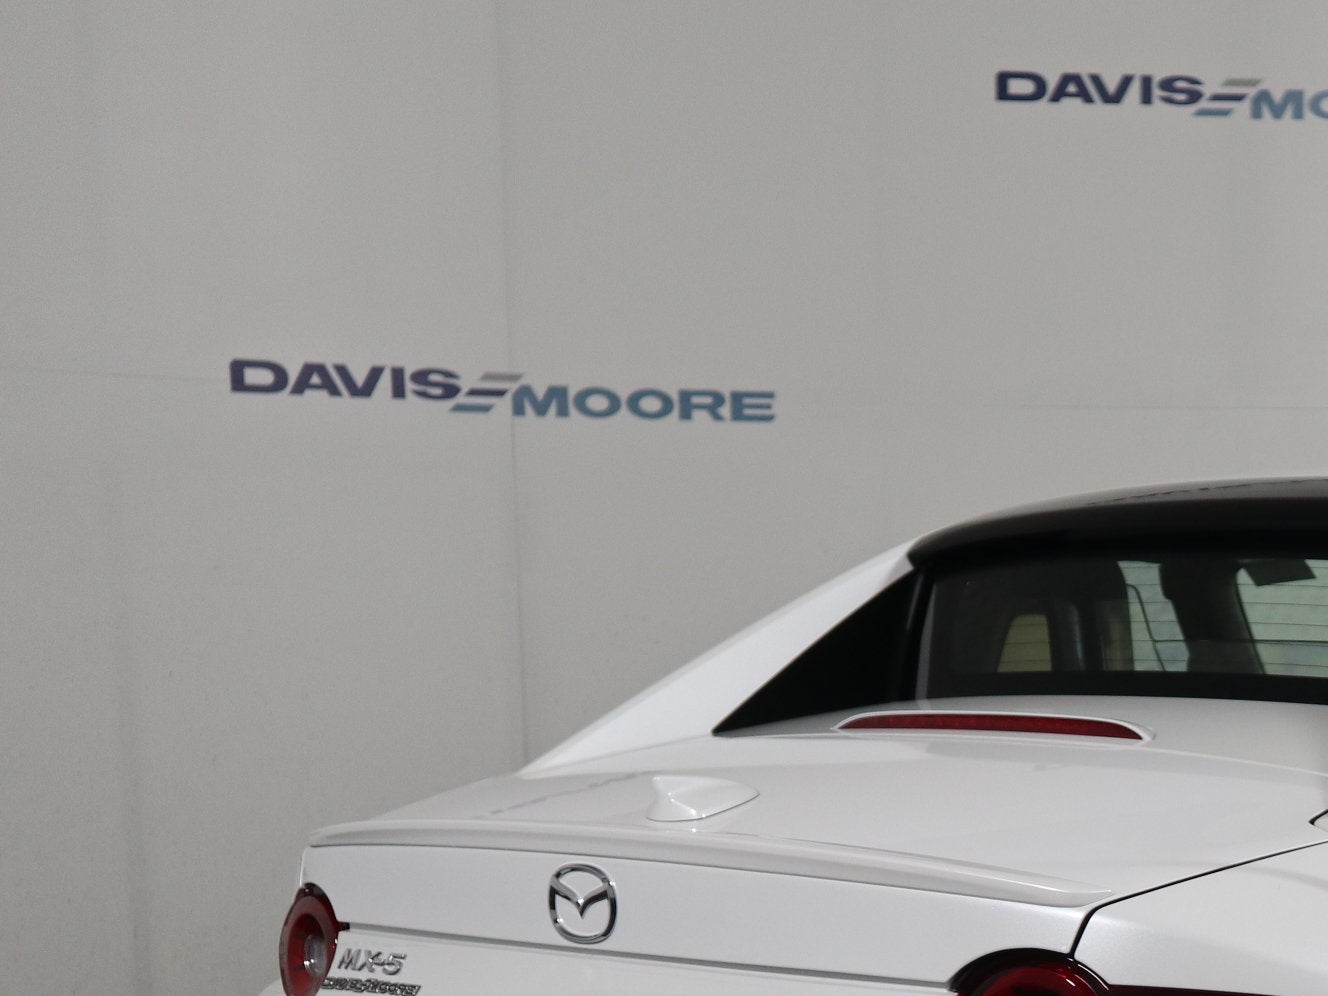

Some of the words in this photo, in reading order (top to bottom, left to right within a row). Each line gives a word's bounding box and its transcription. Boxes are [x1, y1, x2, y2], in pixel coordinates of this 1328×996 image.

[994, 69, 1206, 107] DAVIS
[228, 358, 463, 402] DAVIS
[511, 384, 776, 424] MOORE
[337, 948, 407, 976] MX-5
